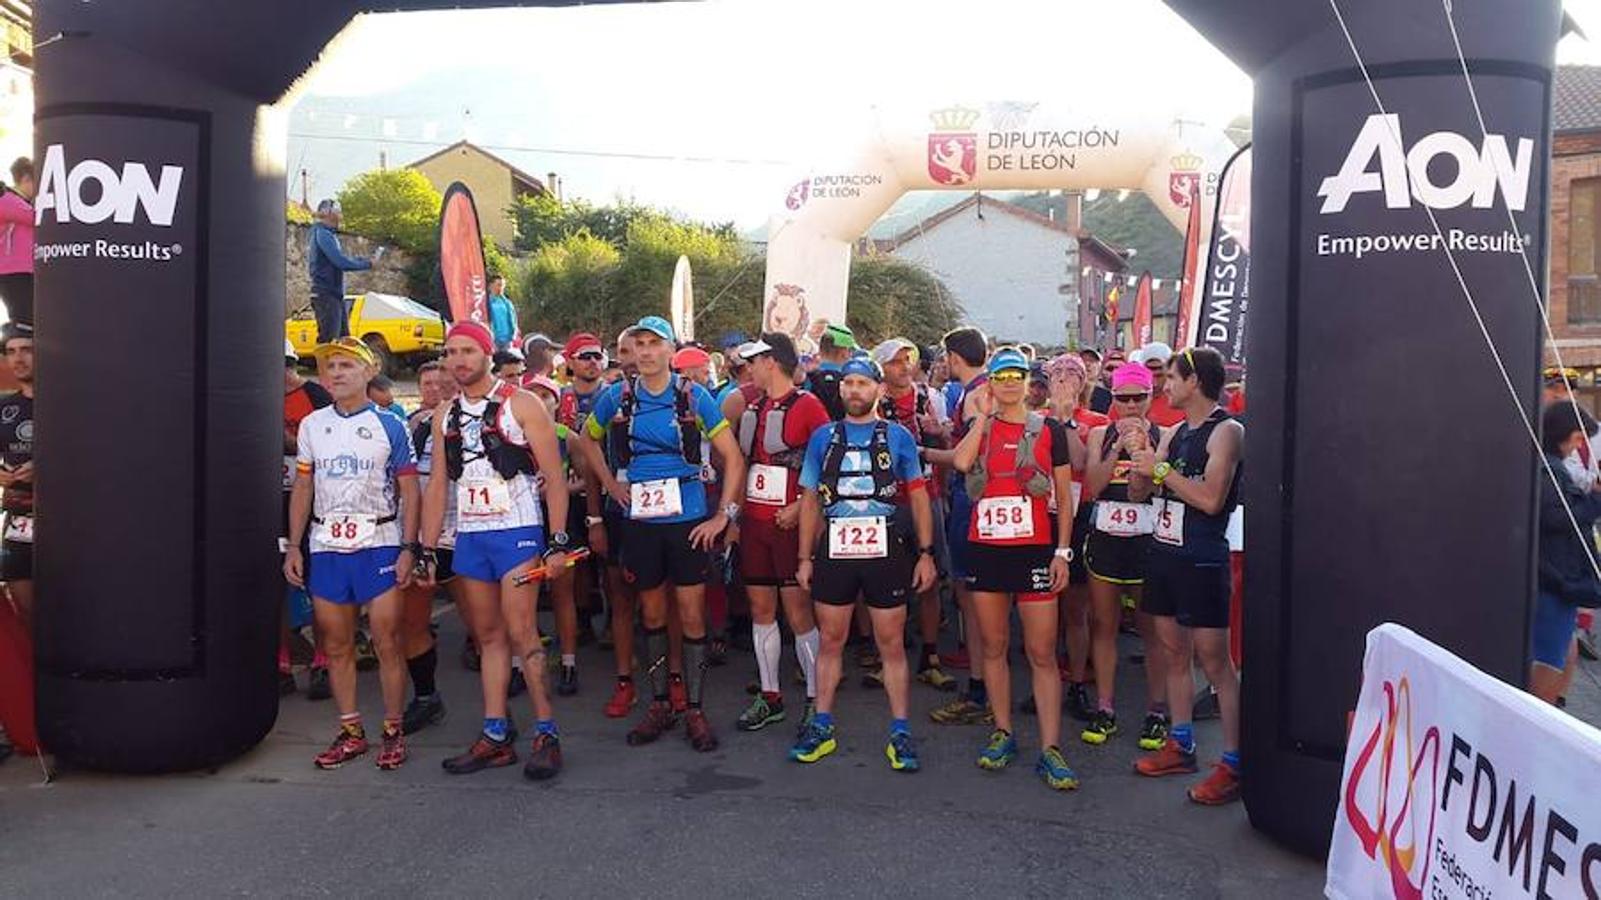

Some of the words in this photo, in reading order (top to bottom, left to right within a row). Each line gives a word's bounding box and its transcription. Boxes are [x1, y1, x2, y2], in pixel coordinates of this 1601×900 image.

[988, 125, 1119, 149] DIPUTACIÓN
[987, 154, 1013, 170] DE
[1019, 149, 1075, 170] LEÓN
[1317, 113, 1534, 213] AON
[35, 143, 183, 226] AON
[812, 187, 827, 198] DE
[1317, 231, 1444, 258] Empower
[1203, 206, 1246, 350] DMESCYL
[755, 473, 765, 490] 8
[468, 487, 490, 505] 71
[641, 490, 666, 508] 22
[984, 506, 1024, 526] 158
[1111, 509, 1138, 525] 49
[331, 522, 357, 539] 88
[838, 526, 878, 545] 122
